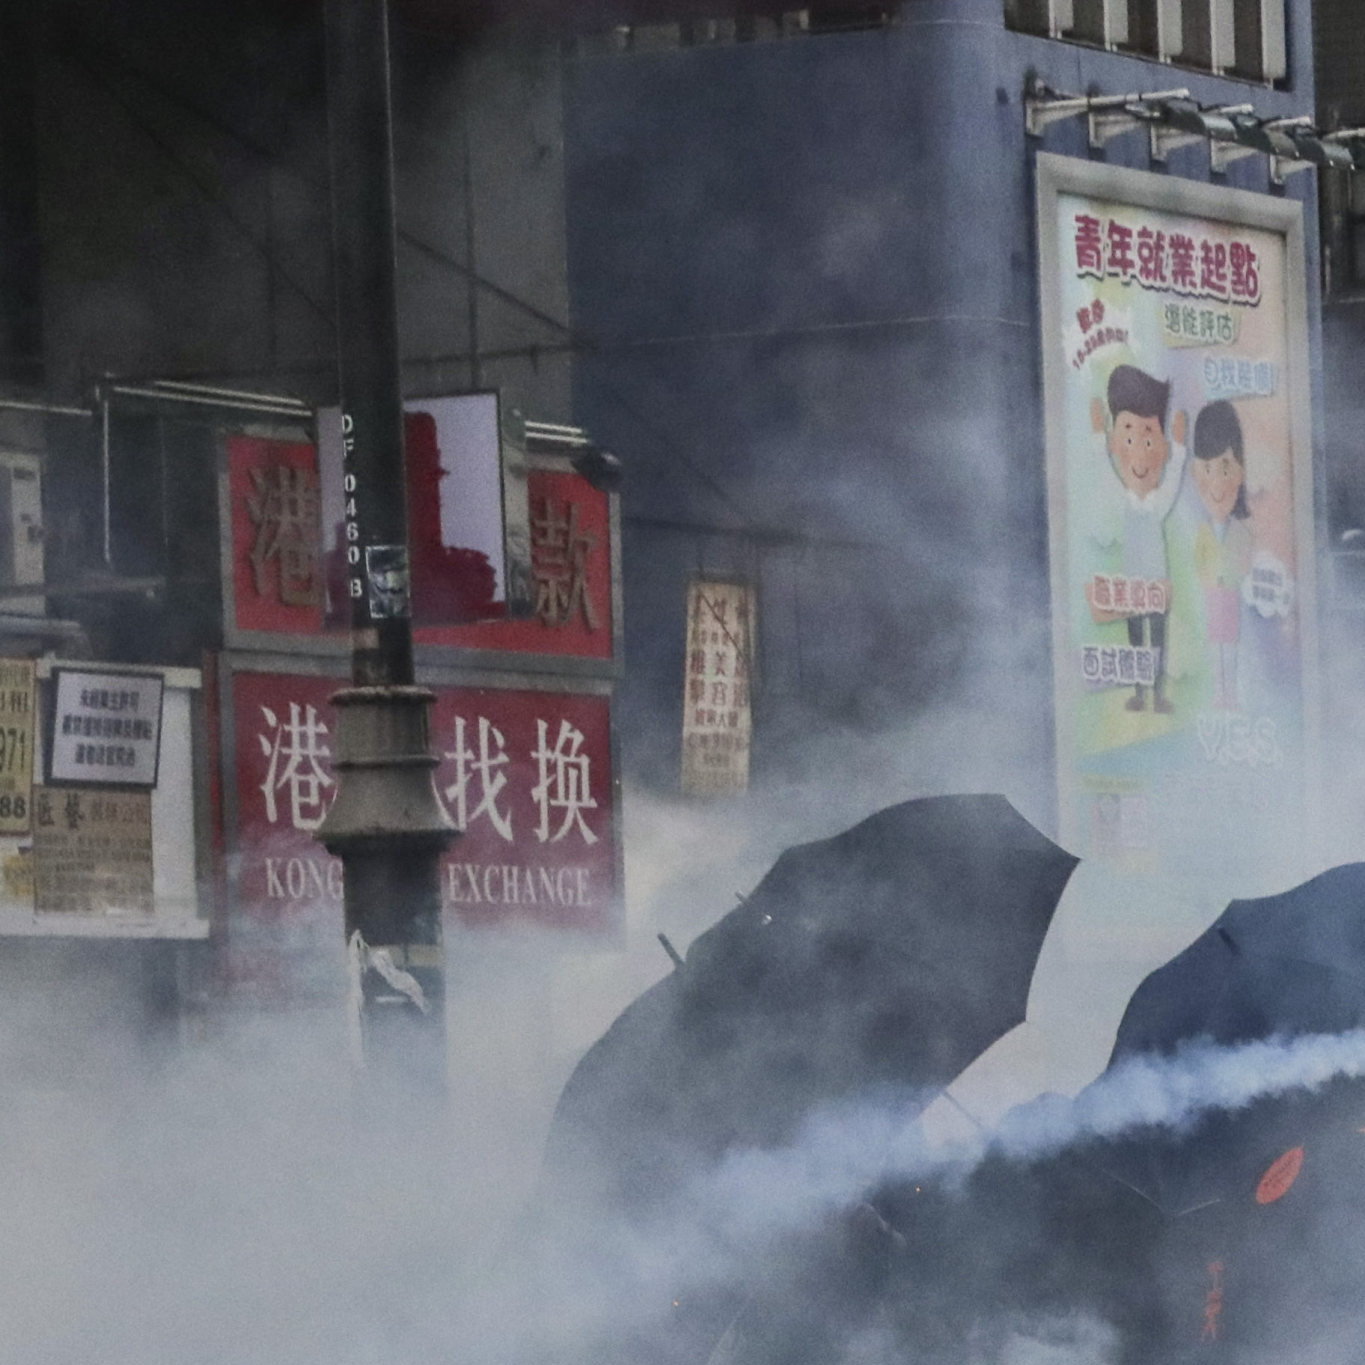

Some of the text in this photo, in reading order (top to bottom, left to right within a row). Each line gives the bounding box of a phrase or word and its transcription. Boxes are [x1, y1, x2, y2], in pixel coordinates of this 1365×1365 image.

[1075, 214, 1259, 298] 青年就業起點
[344, 473, 361, 566] 0460
[350, 580, 363, 599] B
[259, 702, 599, 845] 港找换
[447, 862, 593, 907] EXCHANGE
